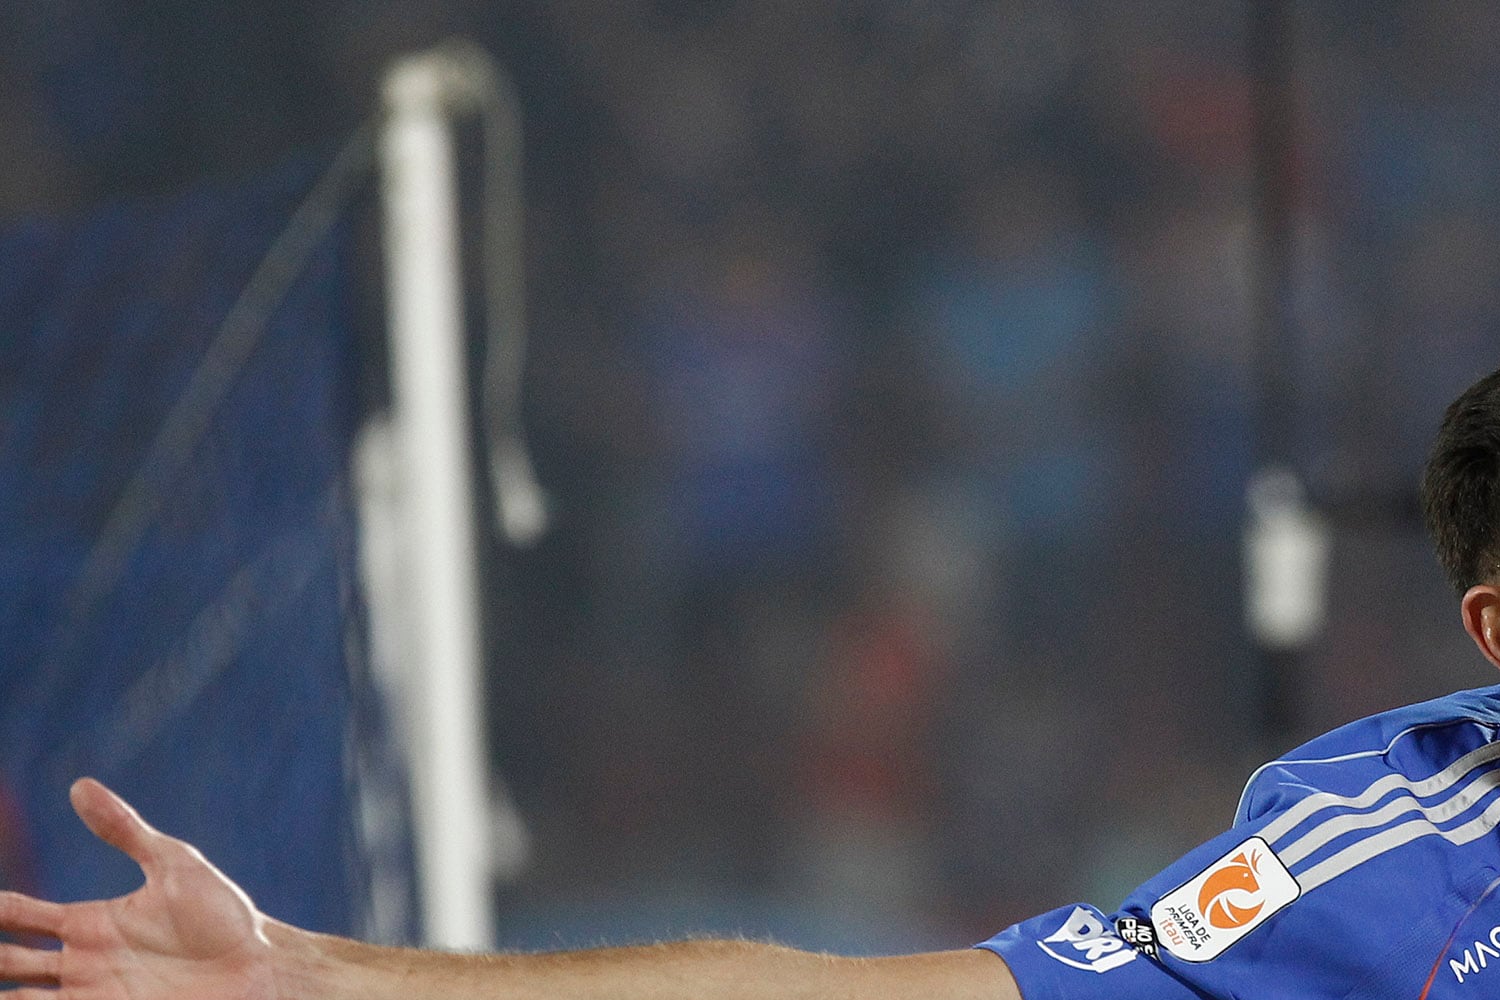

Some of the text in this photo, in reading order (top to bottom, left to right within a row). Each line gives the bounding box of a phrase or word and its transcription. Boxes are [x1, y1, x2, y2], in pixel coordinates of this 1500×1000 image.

[1165, 906, 1202, 951] PRIMERA
[1178, 903, 1211, 943] LIGA DE
